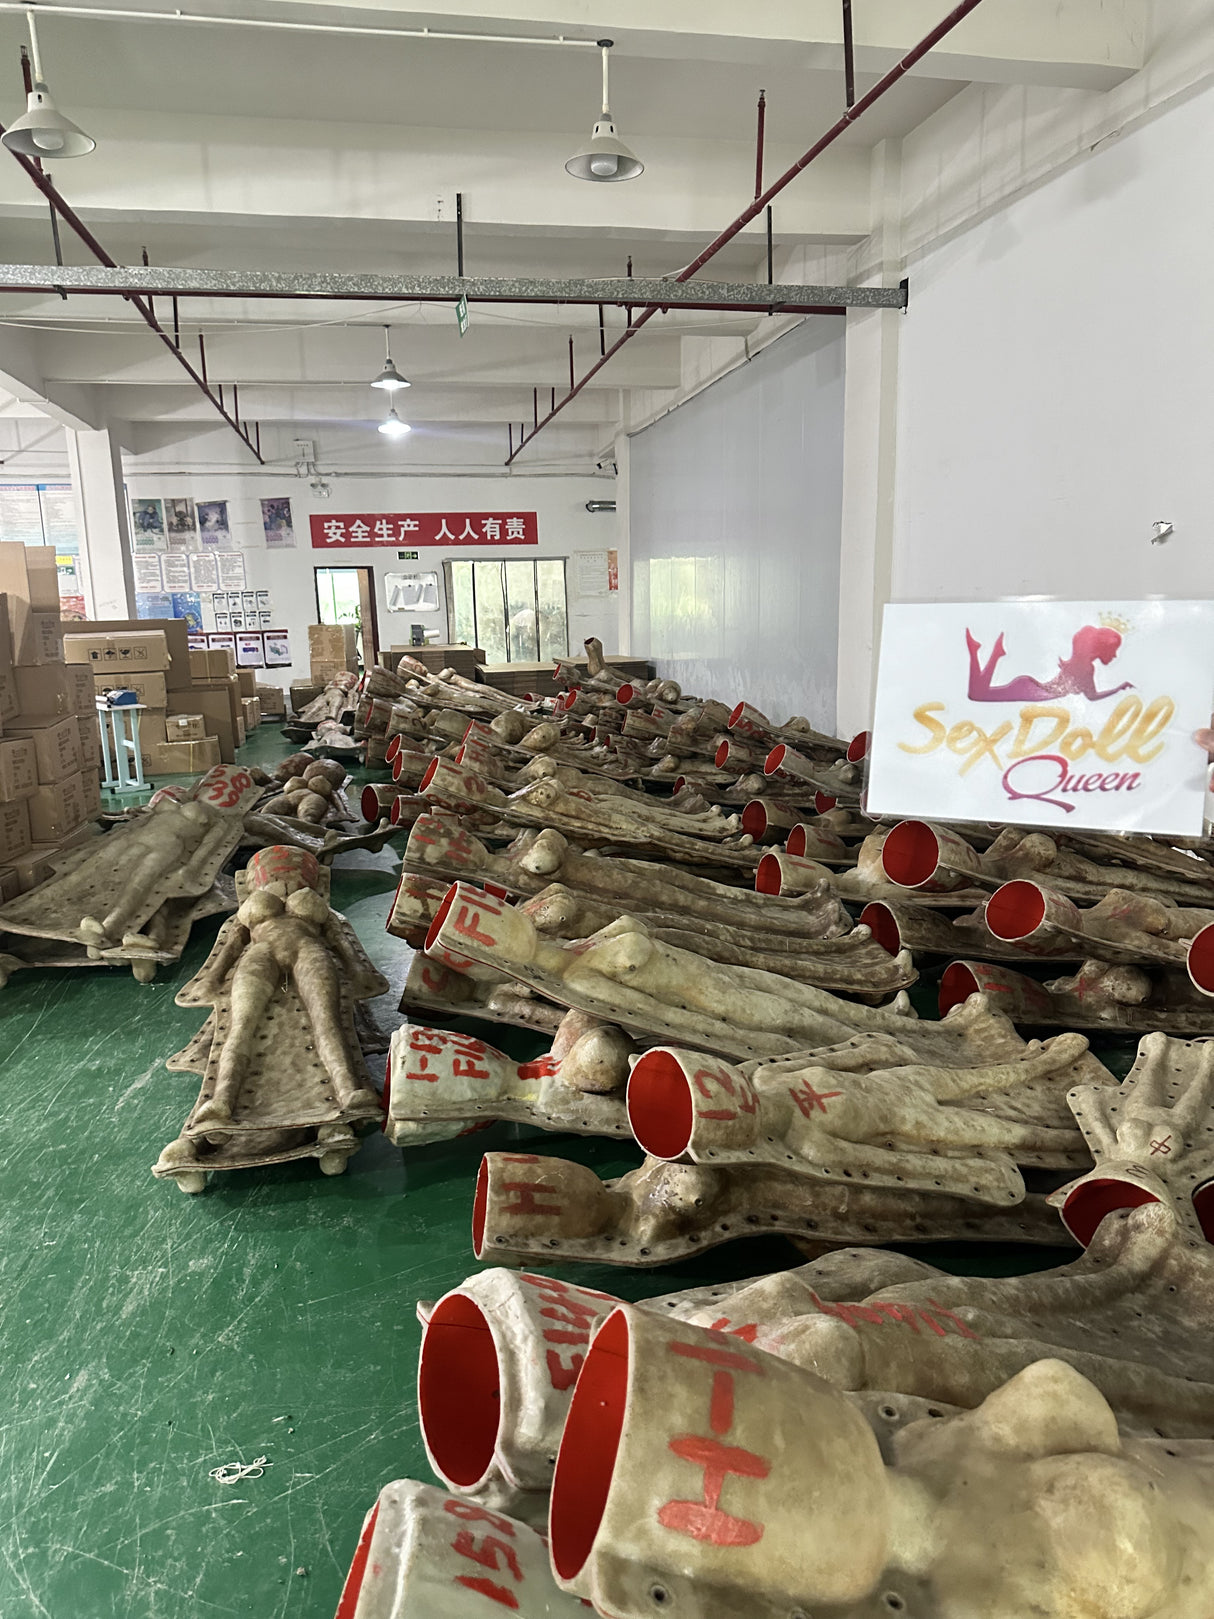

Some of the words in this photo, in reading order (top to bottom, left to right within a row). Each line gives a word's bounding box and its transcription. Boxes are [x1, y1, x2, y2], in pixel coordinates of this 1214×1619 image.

[323, 519, 419, 543] 安全生产
[434, 517, 526, 541] 人人有责
[1001, 754, 1142, 815] Queen
[656, 1331, 773, 1547] H-1
